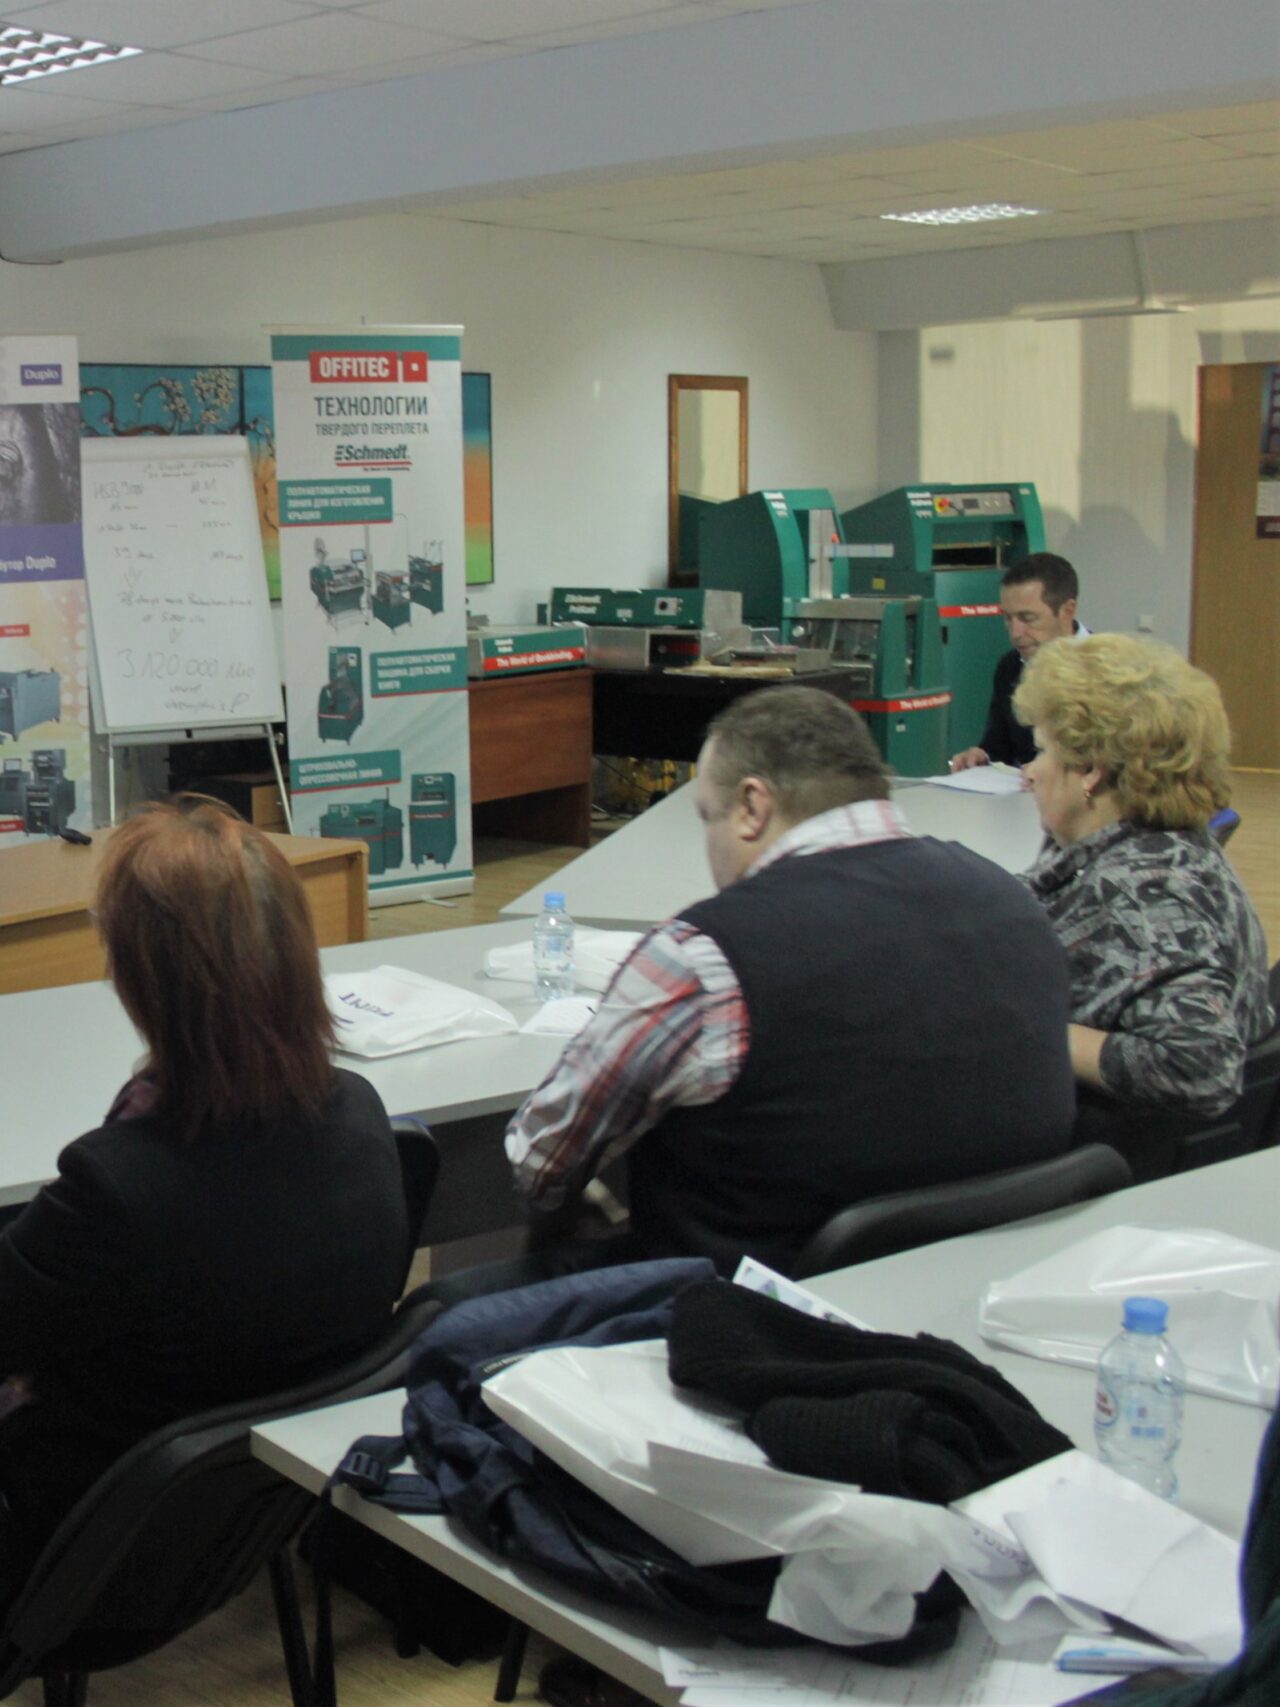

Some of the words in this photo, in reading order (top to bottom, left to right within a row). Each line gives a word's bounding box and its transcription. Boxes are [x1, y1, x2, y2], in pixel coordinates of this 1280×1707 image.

[320, 356, 390, 378] OFFITEC
[24, 369, 60, 383] Duplo
[314, 396, 428, 416] ТЕХНОЛОГИИ
[315, 423, 369, 437] ТВЕРДОГО
[372, 422, 429, 435] ПЕРЕПЛЕТА
[25, 555, 57, 572] Duplo
